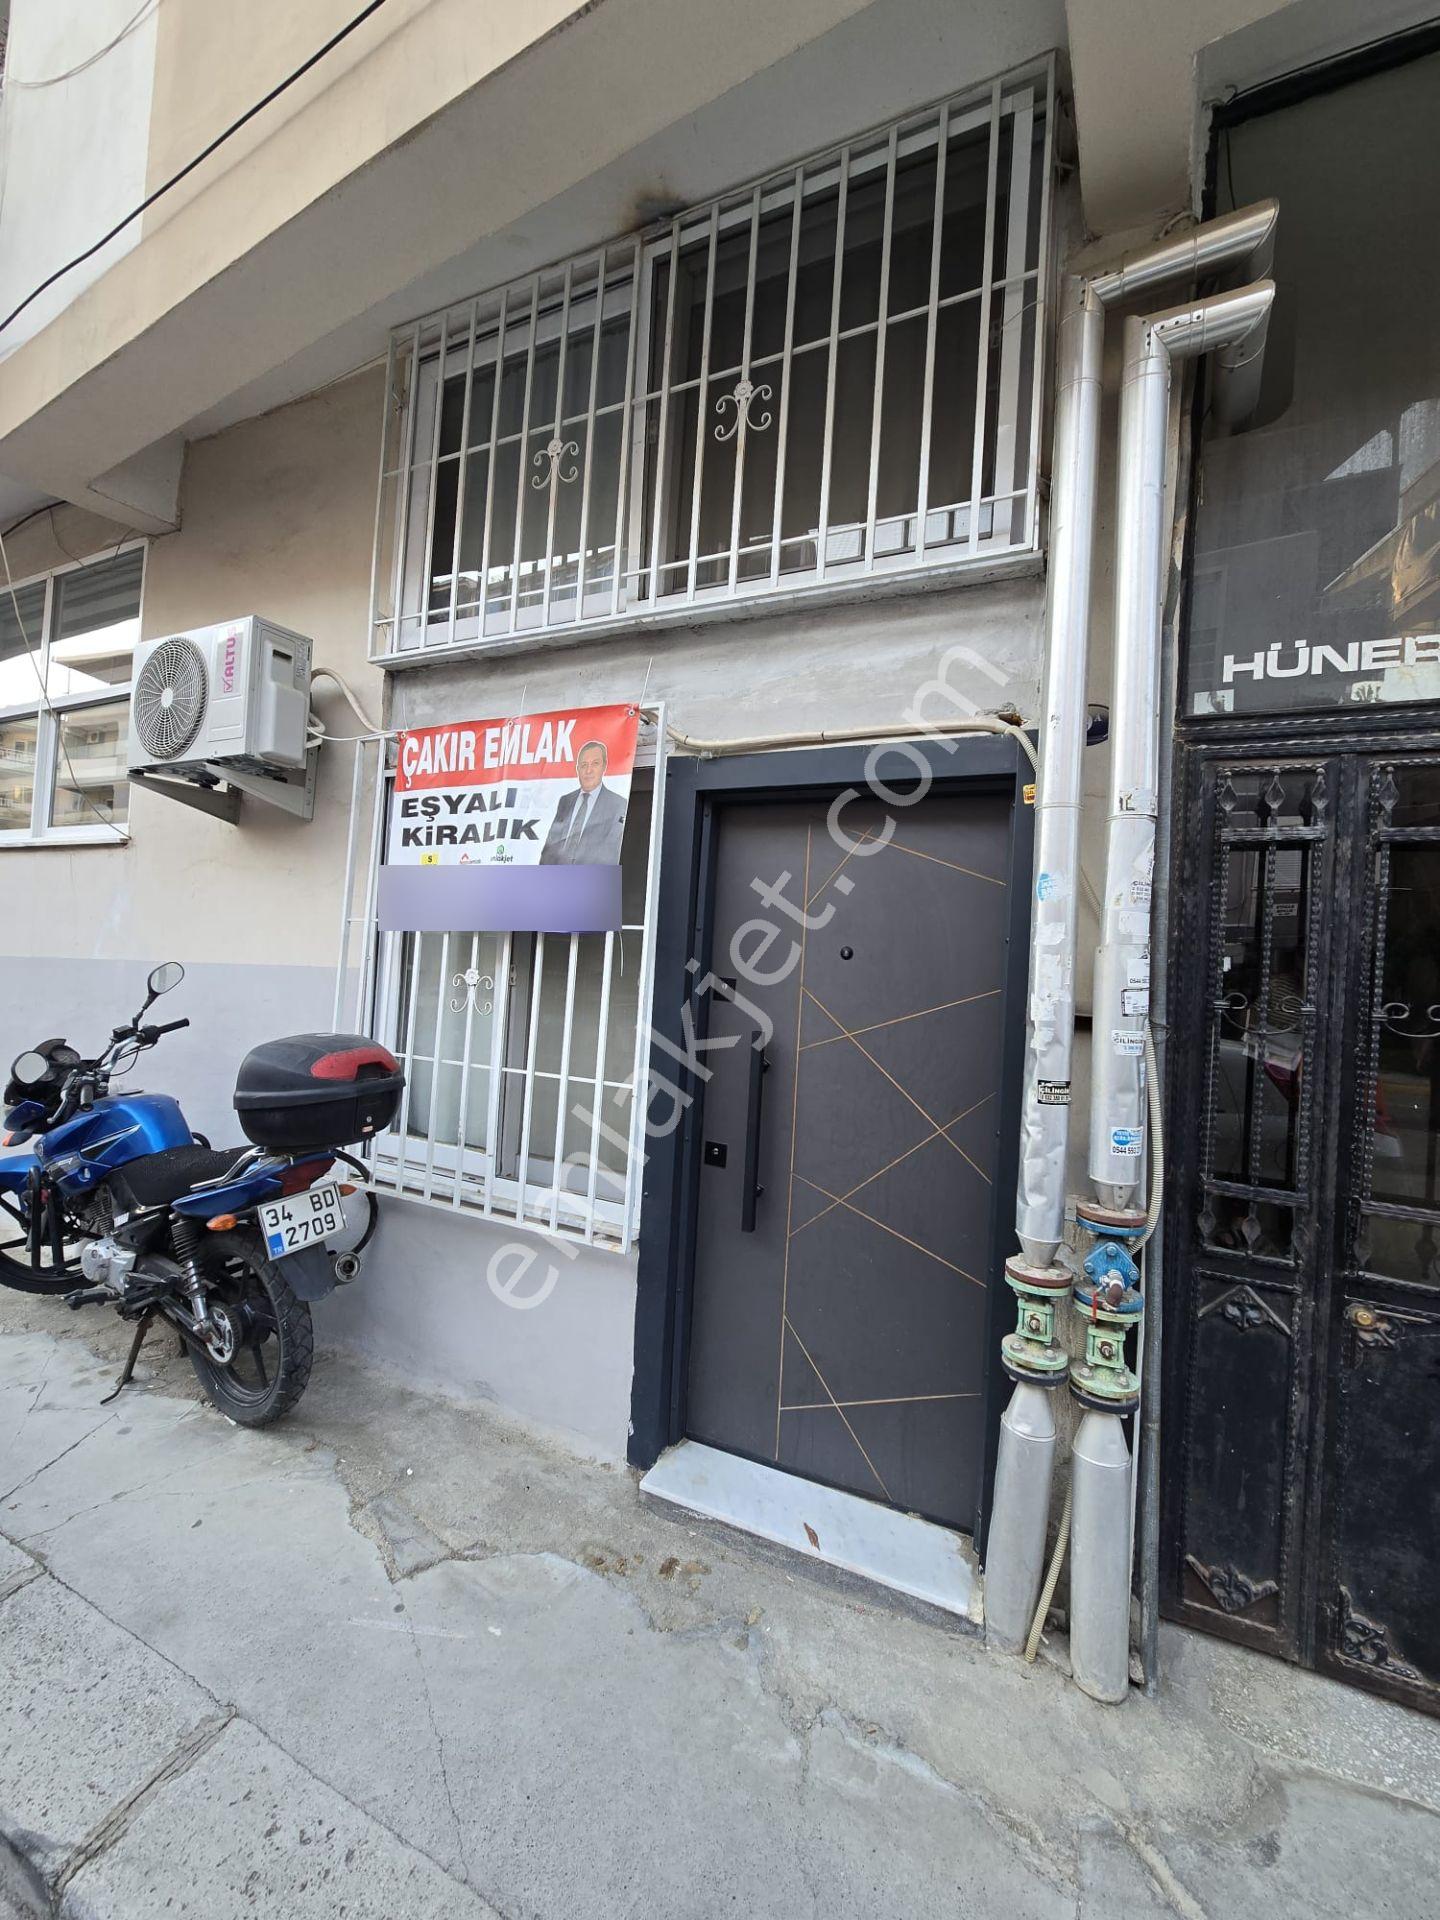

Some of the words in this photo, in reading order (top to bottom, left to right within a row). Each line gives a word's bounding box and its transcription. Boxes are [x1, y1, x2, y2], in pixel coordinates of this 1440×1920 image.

[1222, 633, 1440, 683] HÜNER
[402, 731, 476, 788] ÇAKIR
[483, 719, 577, 769] EMLAK
[401, 787, 518, 822] EŞYALI
[401, 818, 541, 847] KİRALIK
[265, 1204, 293, 1228] 34
[309, 1189, 335, 1213] BD
[285, 1212, 336, 1247] 2709
[273, 1247, 284, 1255] TR
